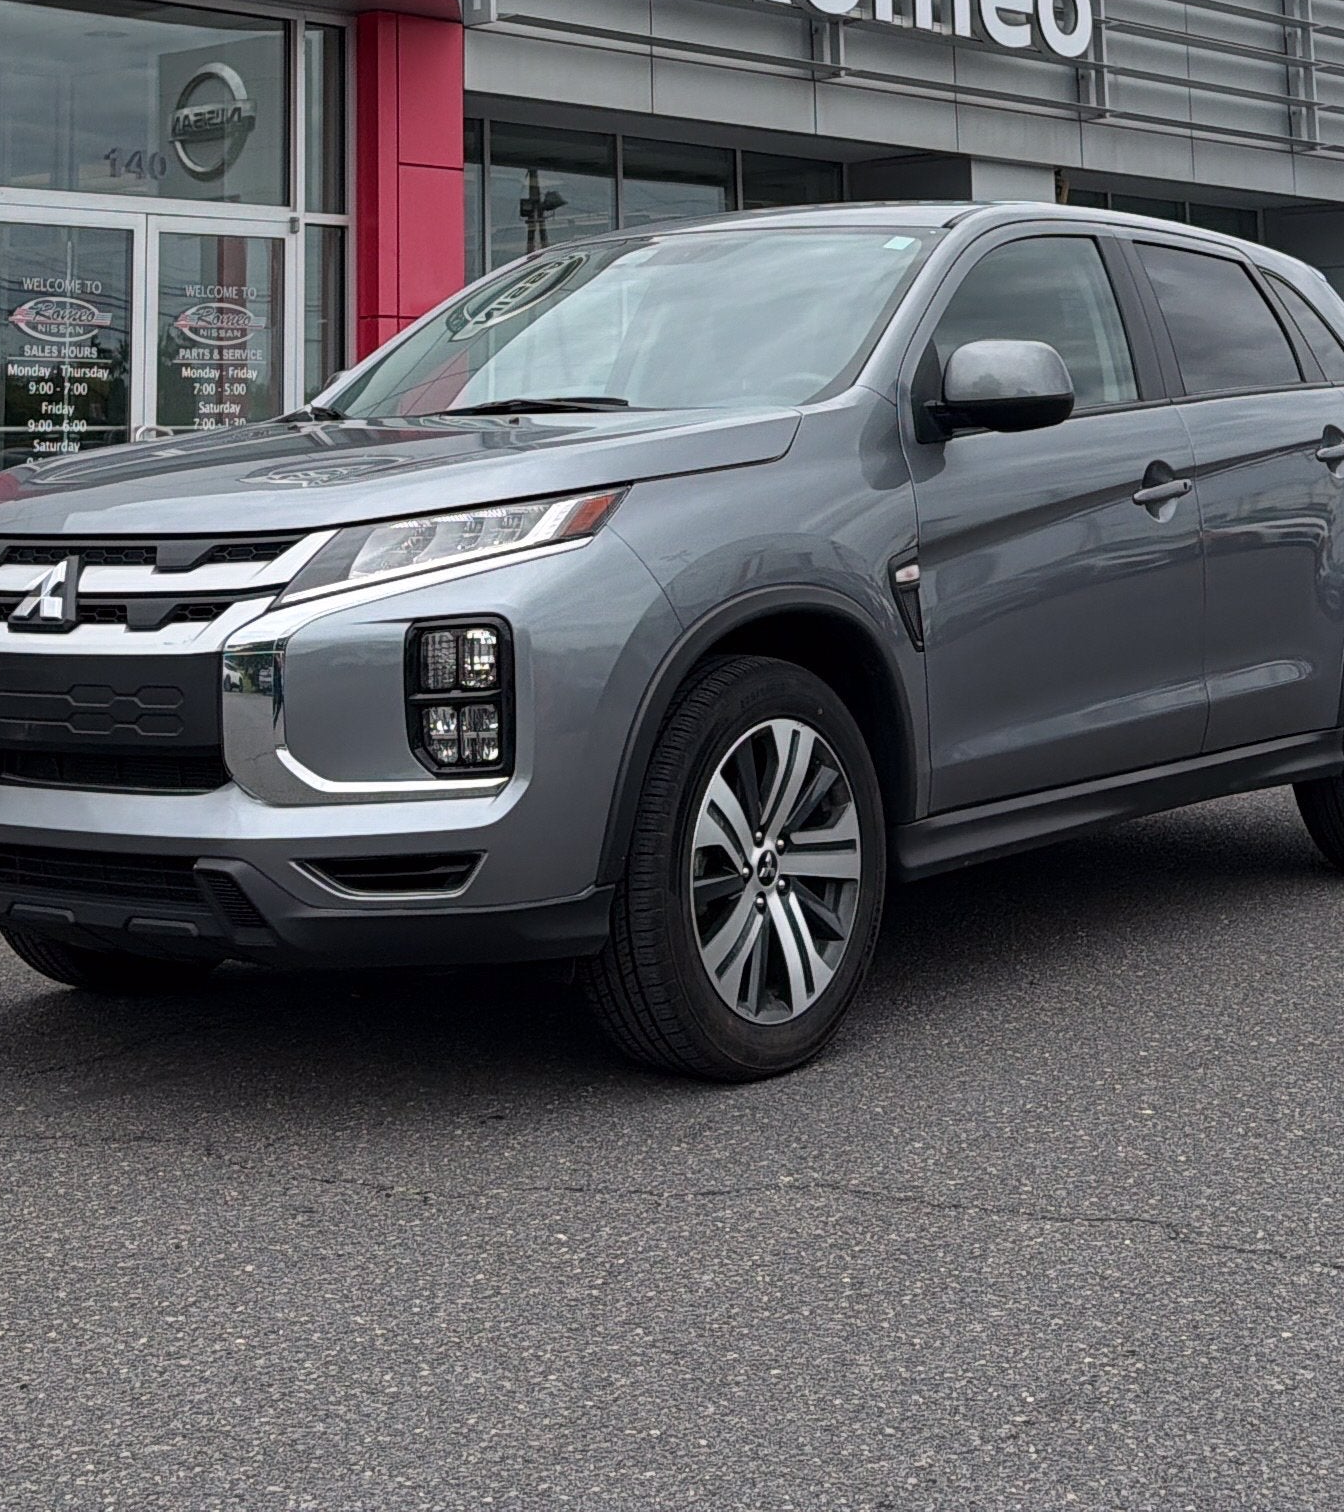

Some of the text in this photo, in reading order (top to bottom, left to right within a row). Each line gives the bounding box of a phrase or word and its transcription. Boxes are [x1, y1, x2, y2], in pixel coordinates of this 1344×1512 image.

[104, 147, 168, 181] 140
[22, 278, 102, 295] WELCOME TO
[185, 285, 257, 299] WELCOME TO
[30, 300, 97, 324] Romeo
[193, 305, 252, 326] Romeo
[38, 324, 85, 335] NISSAN
[199, 329, 242, 338] NISSAN
[24, 344, 98, 359] SALES HOURS
[179, 348, 263, 361] PARTS & SERVICE
[8, 363, 51, 379] Monday
[60, 365, 110, 381] Thursday
[181, 366, 221, 380] Monday
[228, 366, 258, 380] Friday
[28, 382, 54, 395] 9:00
[63, 382, 88, 396] 7:00
[193, 383, 216, 395] 7:00
[224, 383, 247, 395] 5:00
[41, 401, 75, 417] Friday
[198, 401, 241, 415] Saturday
[27, 419, 53, 433] 9:00
[62, 419, 87, 433] 6:00
[193, 418, 216, 430] 7:00
[33, 438, 81, 454] Saturday
